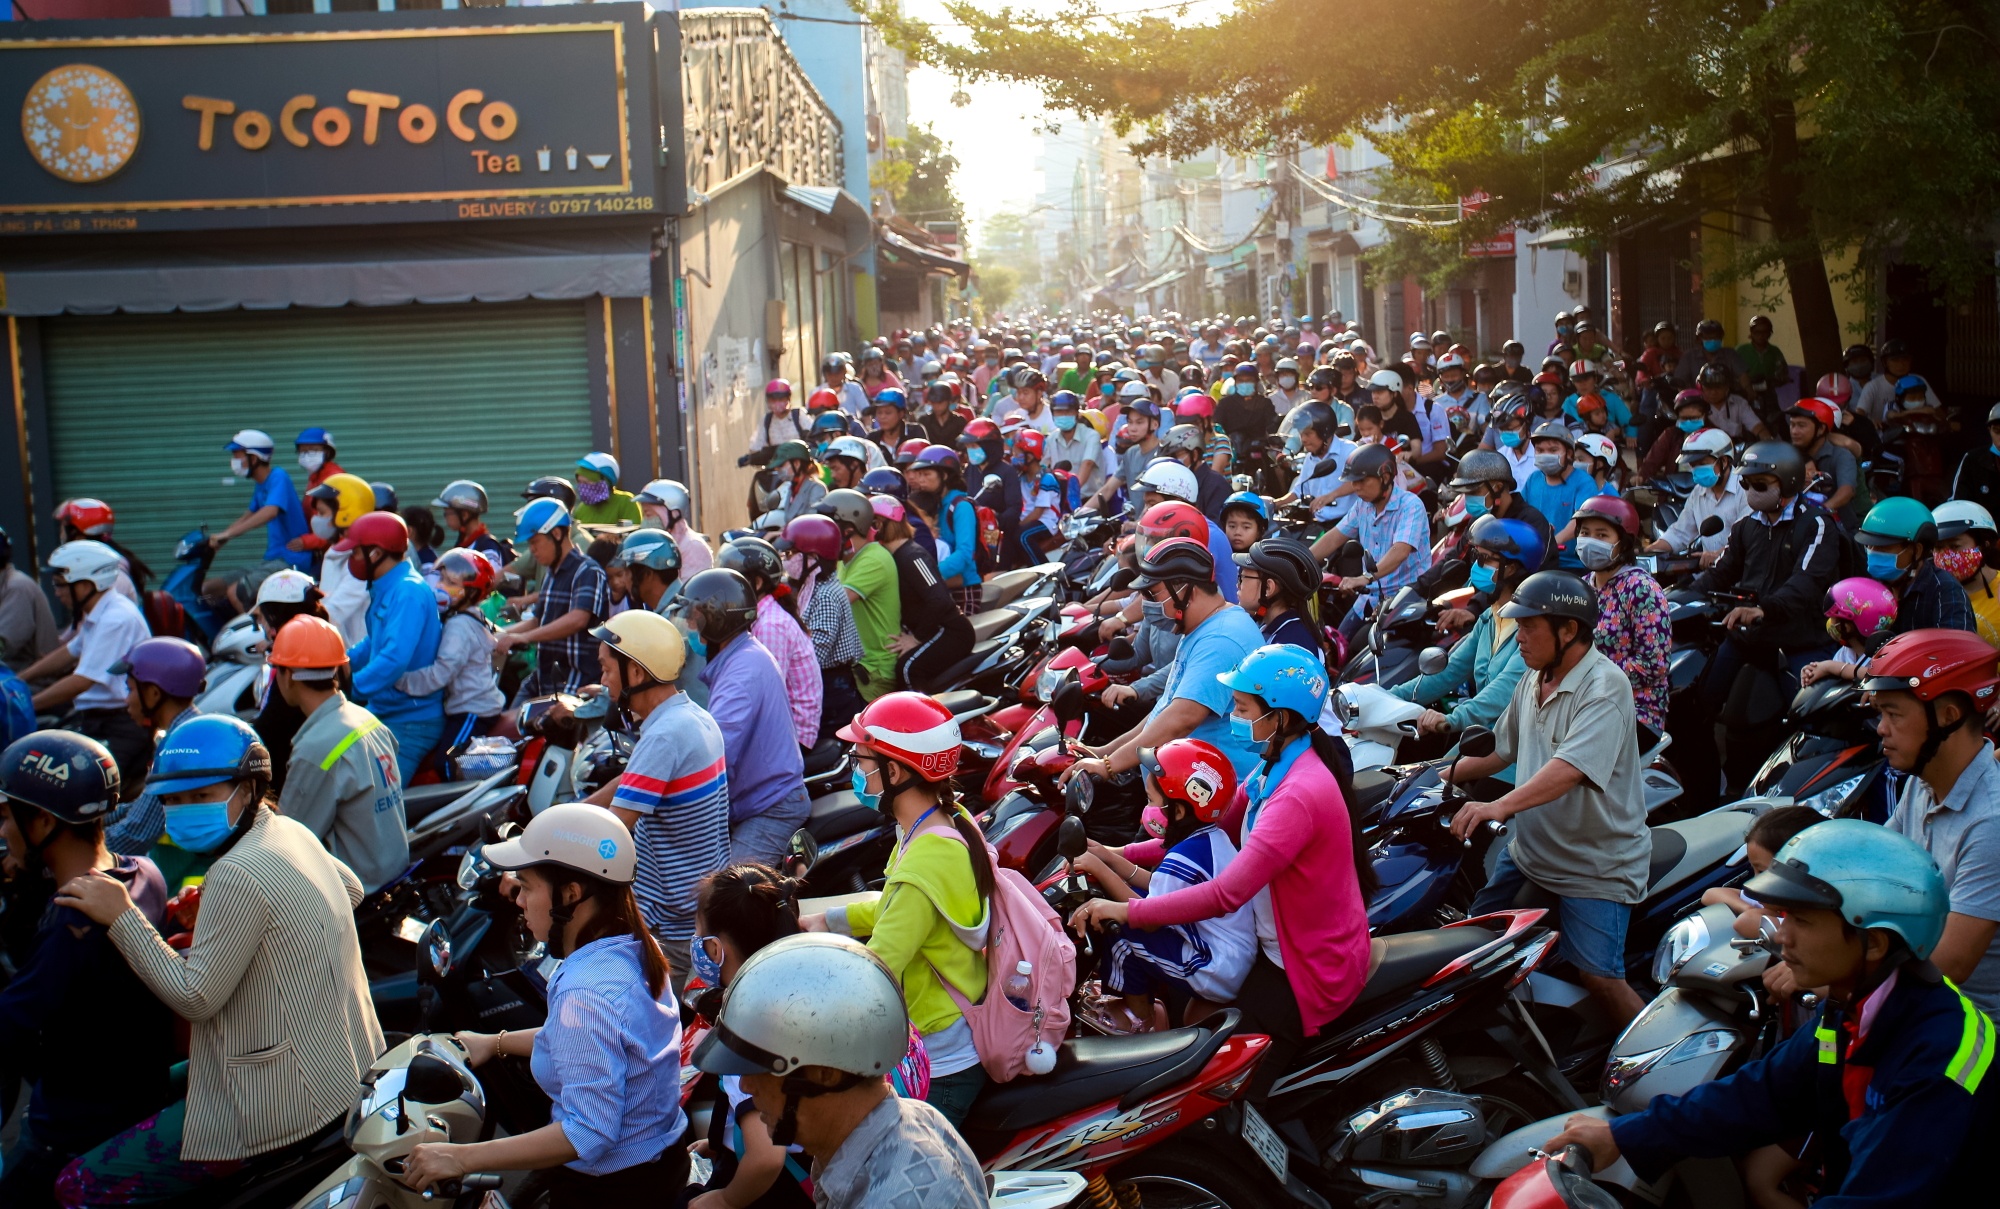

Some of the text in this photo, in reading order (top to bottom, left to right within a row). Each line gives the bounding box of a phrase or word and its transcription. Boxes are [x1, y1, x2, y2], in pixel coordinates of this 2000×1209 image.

[471, 149, 522, 174] Tea
[458, 201, 536, 218] DELIVERY
[549, 199, 590, 215] 0797
[594, 196, 654, 212] 140218
[1561, 594, 1573, 605] My
[1574, 595, 1588, 606] Bike
[165, 747, 200, 755] HONDA
[23, 750, 69, 781] FILA
[19, 764, 66, 789] WATCHES
[552, 830, 599, 849] PIAGGIO
[479, 1000, 524, 1018] HONDA
